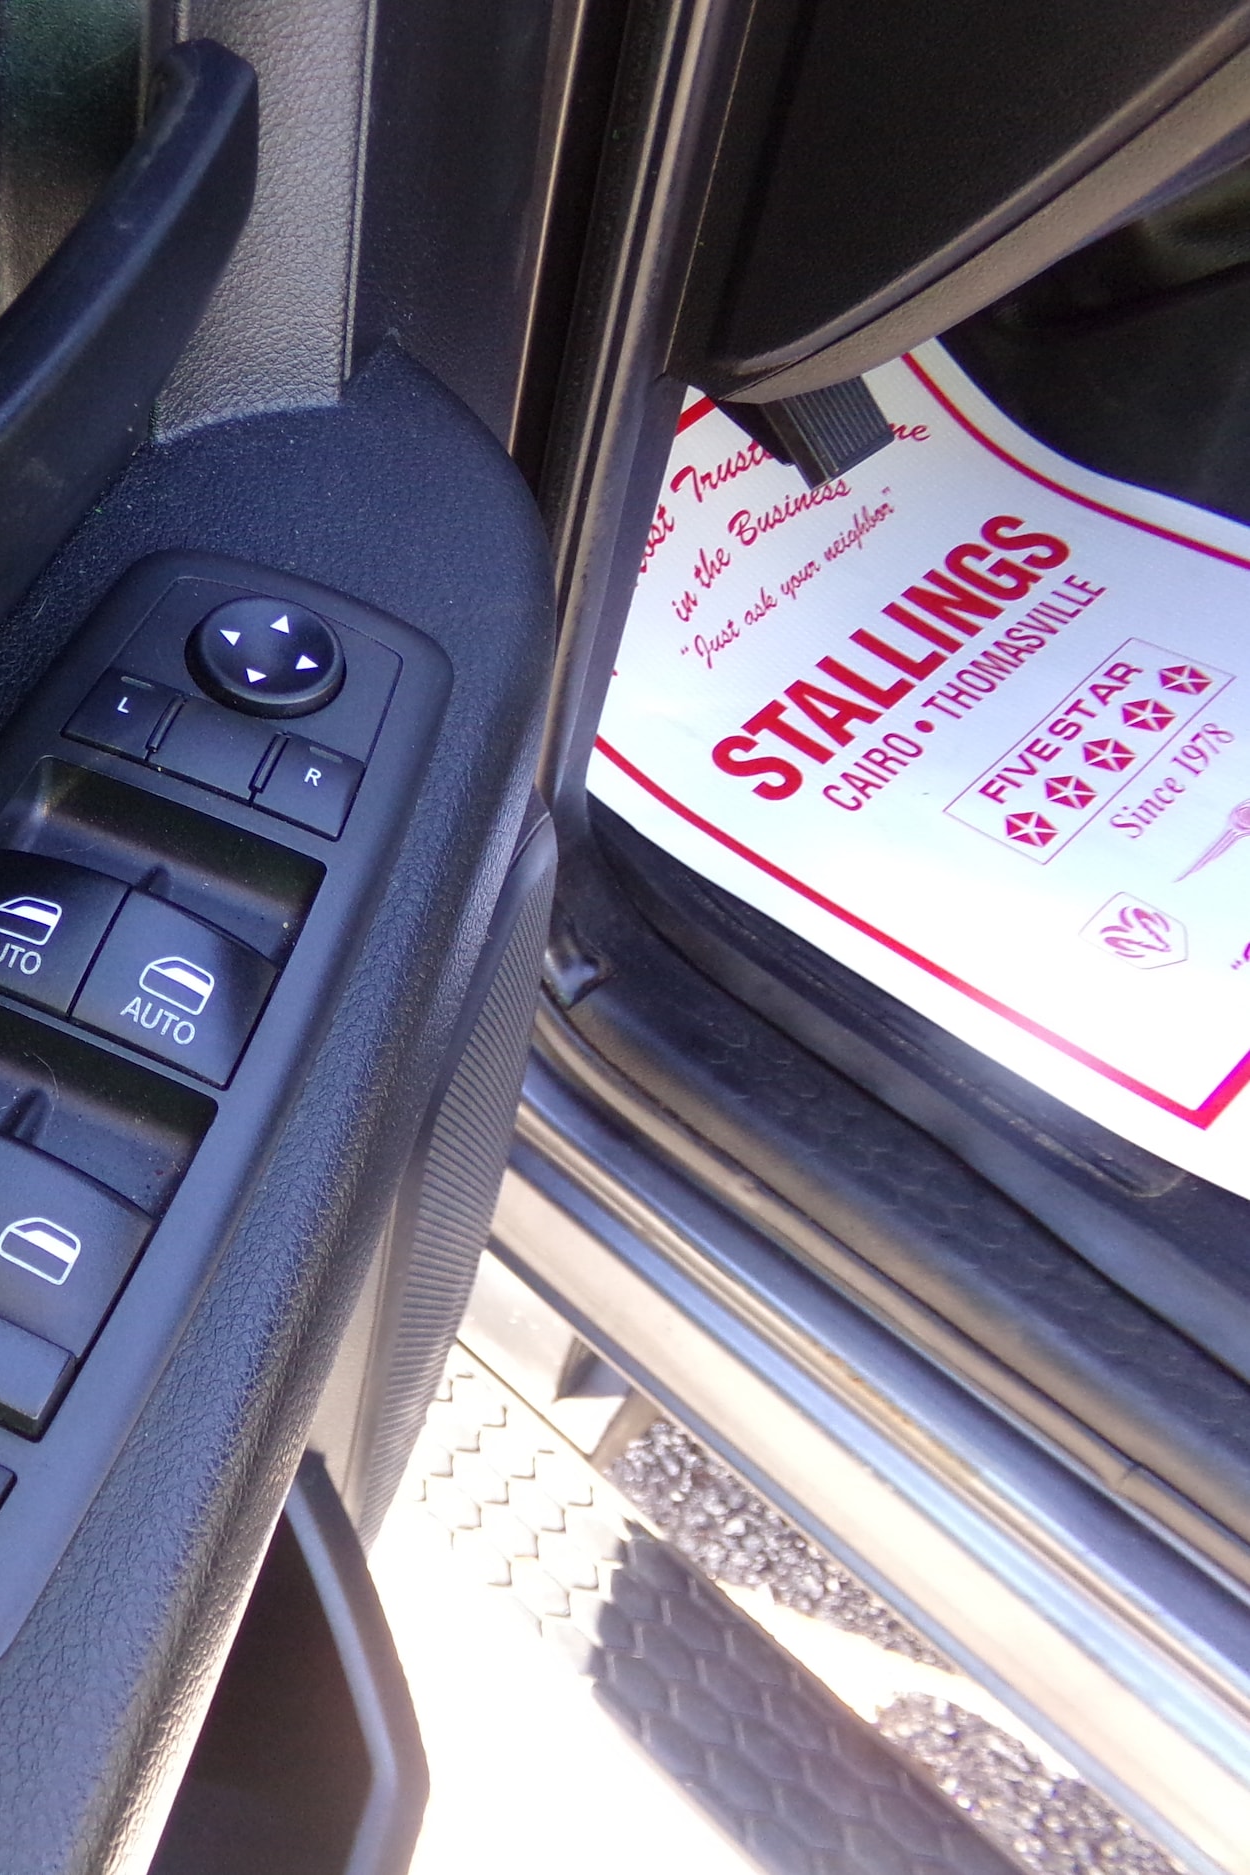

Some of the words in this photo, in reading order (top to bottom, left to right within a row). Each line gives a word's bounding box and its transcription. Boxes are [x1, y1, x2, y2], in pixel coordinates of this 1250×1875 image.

[637, 503, 675, 574] ost
[670, 440, 773, 503] Trust
[672, 590, 699, 622] in
[693, 547, 731, 589] the
[727, 478, 852, 546] Business
[744, 586, 778, 626] ask
[780, 560, 821, 600] your
[117, 697, 129, 714] L
[712, 515, 1071, 801] STALLINGS
[822, 732, 924, 811] CAIRO
[921, 573, 1106, 722] THOMASVILLE
[304, 767, 322, 786] R
[978, 737, 1064, 804] FIVE
[1048, 661, 1144, 743] STAR
[1109, 777, 1186, 839] Since
[1170, 722, 1235, 776] 1978
[120, 996, 196, 1045] AUTO
